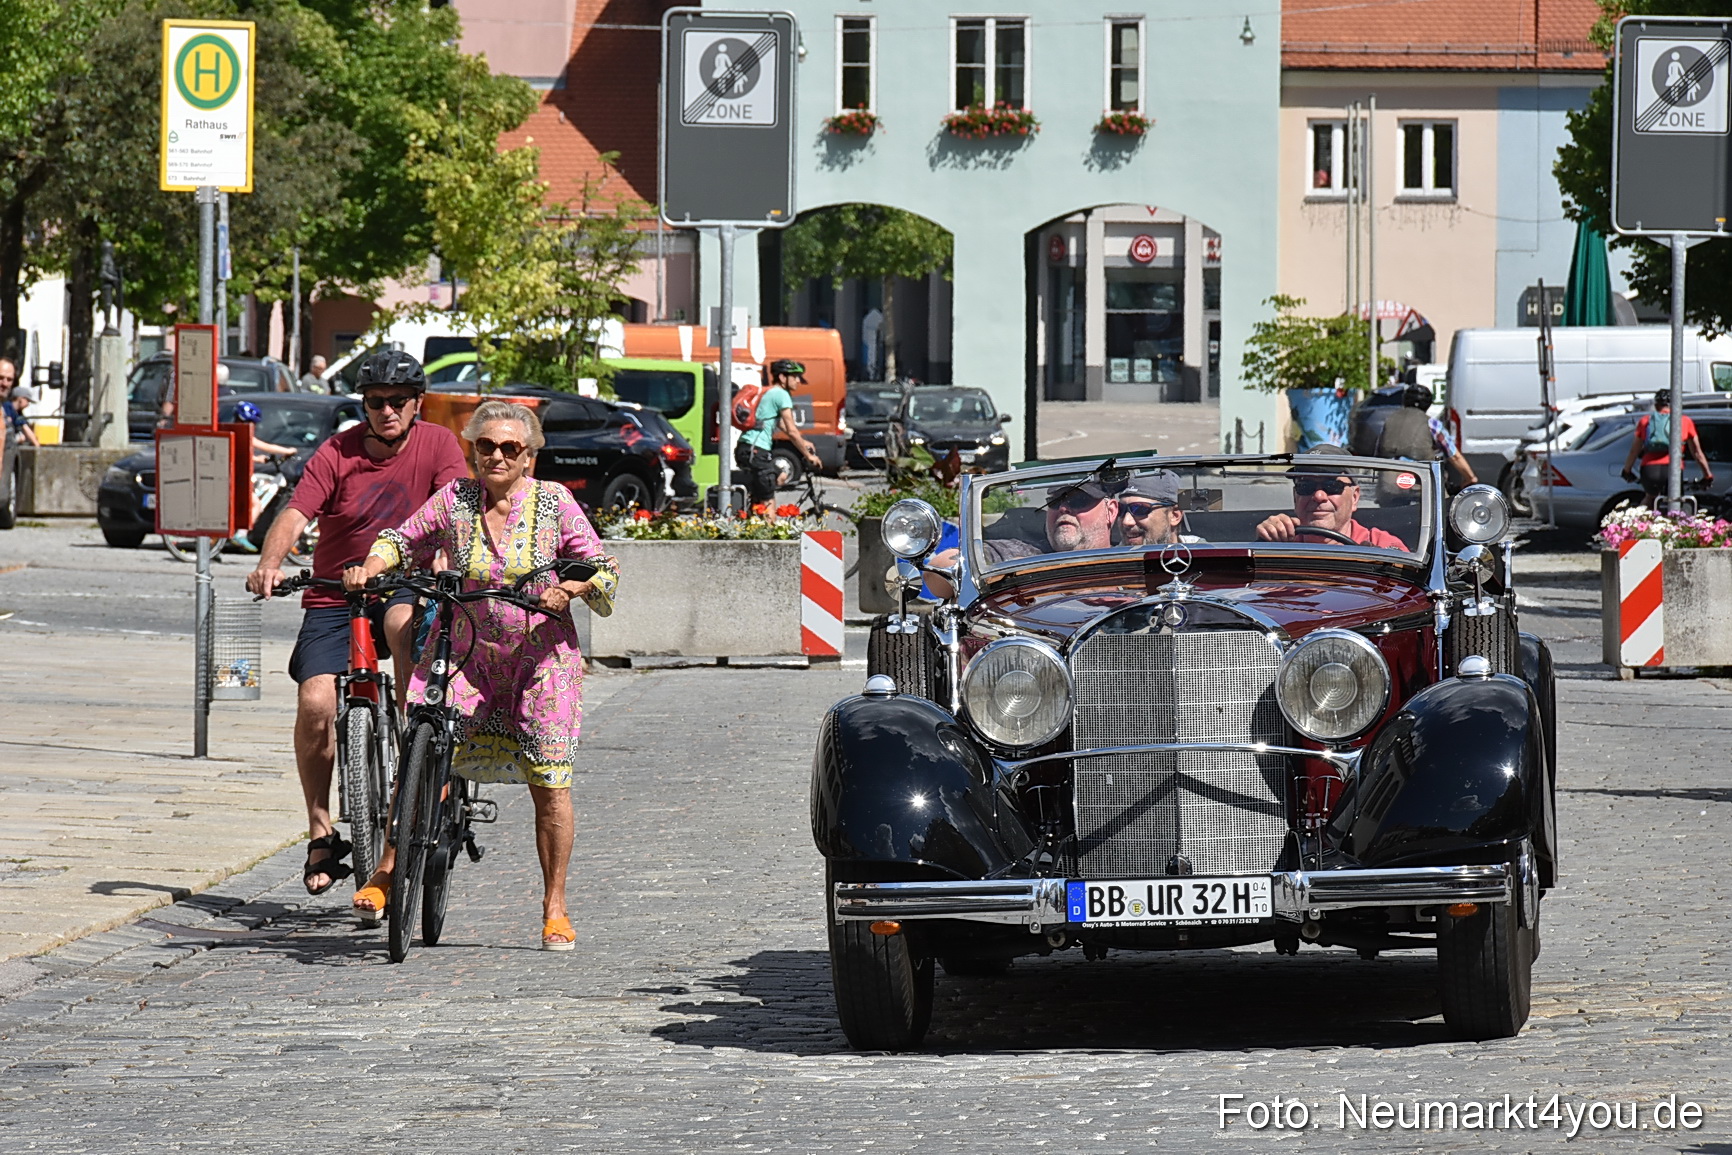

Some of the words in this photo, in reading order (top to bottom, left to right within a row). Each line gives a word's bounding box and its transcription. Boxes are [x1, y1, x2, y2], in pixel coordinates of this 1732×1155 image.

[195, 51, 220, 92] H
[706, 104, 752, 119] ZONE
[185, 118, 229, 130] Rathaus
[1659, 112, 1705, 127] ZONE
[1527, 303, 1565, 316] HD
[1252, 881, 1267, 891] 04
[1088, 886, 1126, 918] BB
[1147, 884, 1184, 916] UR
[1073, 906, 1080, 915] D
[1254, 903, 1268, 913] 10
